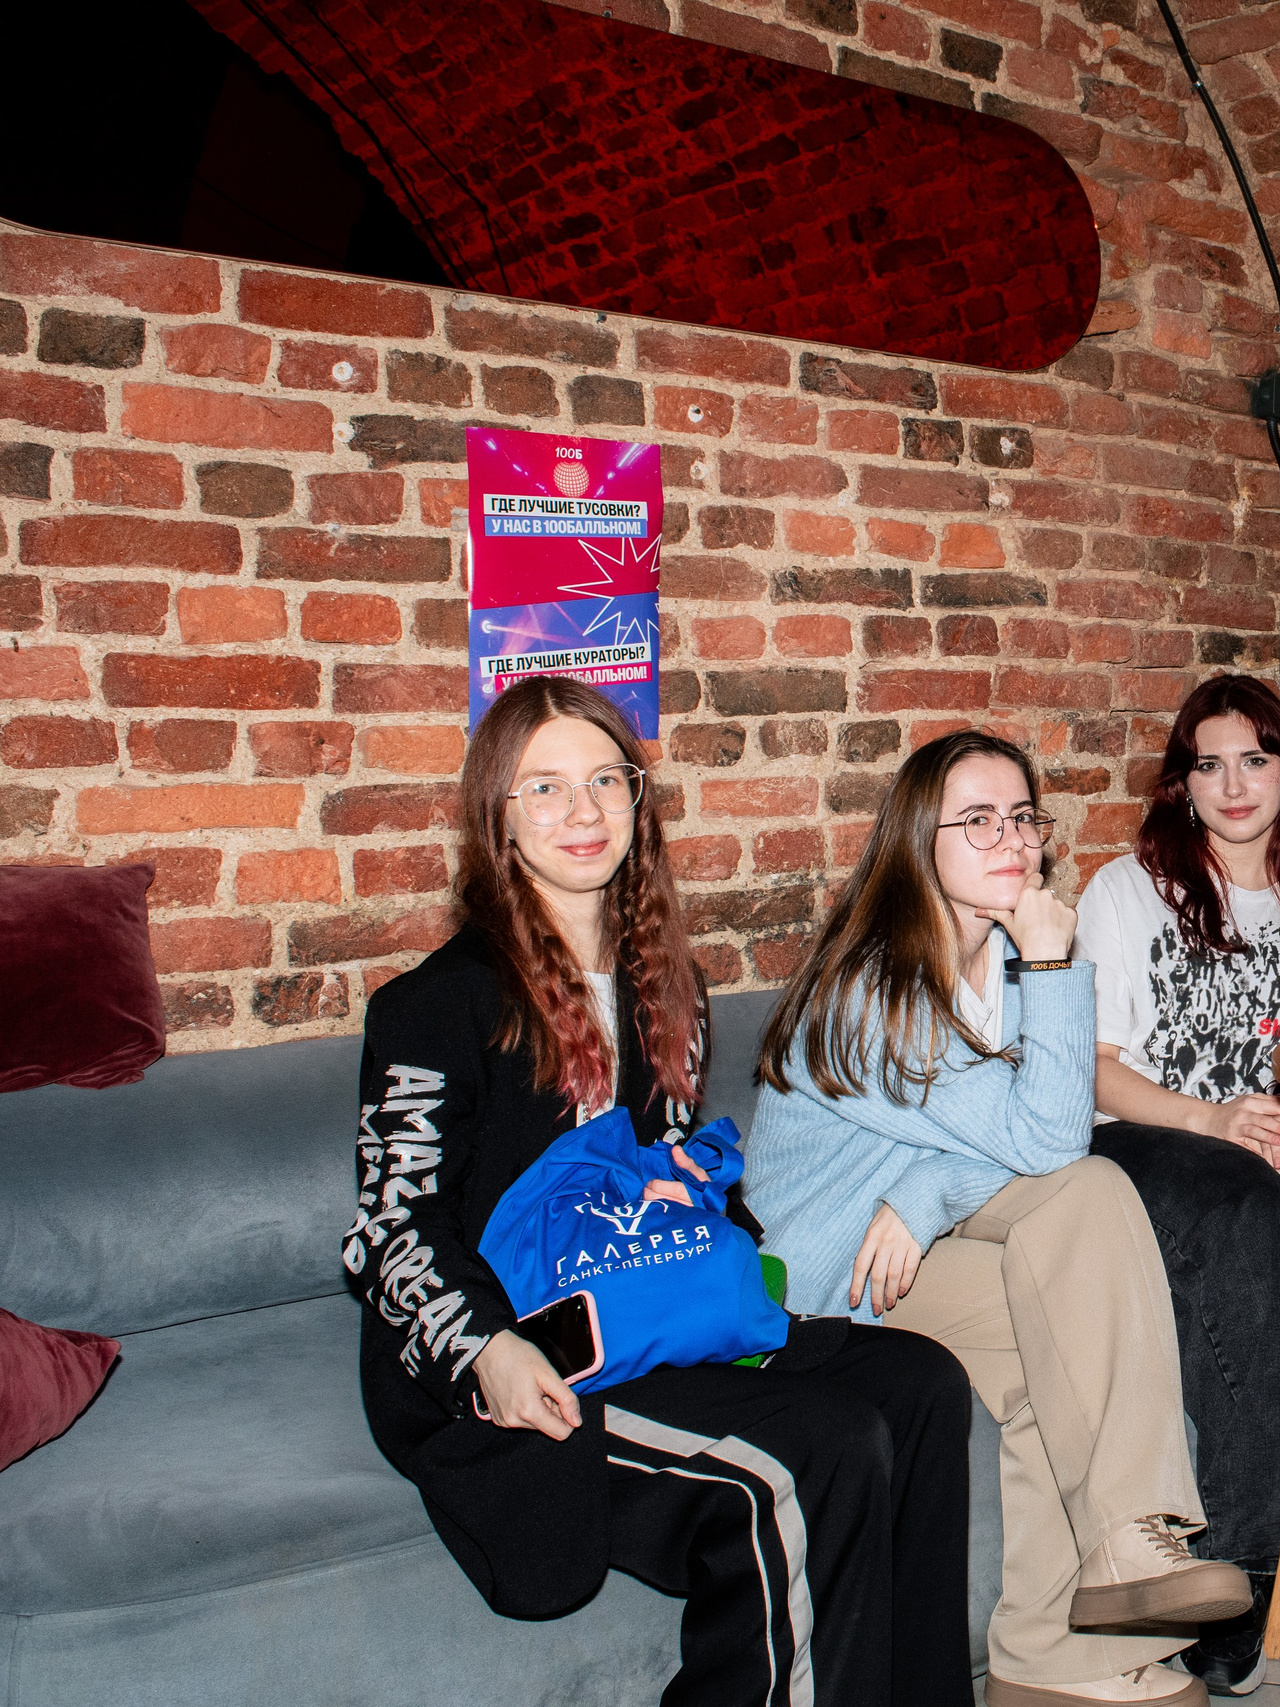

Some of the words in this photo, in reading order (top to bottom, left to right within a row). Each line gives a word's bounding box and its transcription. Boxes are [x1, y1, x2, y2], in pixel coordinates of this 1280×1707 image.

[555, 446, 583, 460] 100Б
[491, 497, 516, 513] ГДЕ
[518, 498, 575, 514] ЛУЧШИЕ
[576, 501, 641, 518] ТУСОВКИ?
[491, 518, 502, 533] У
[503, 518, 531, 534] НАС
[532, 519, 542, 533] В
[543, 519, 642, 535] 100БАЛЛЬНОМ!
[488, 658, 514, 674] ГДЕ
[516, 653, 573, 671] ЛУЧШИЕ
[574, 646, 646, 665] КУРАТОРЫ?
[556, 1225, 711, 1275] ГАЛЕРЕЯ
[557, 1242, 714, 1287] САНКТ-ПЕТЕРБУРГ
